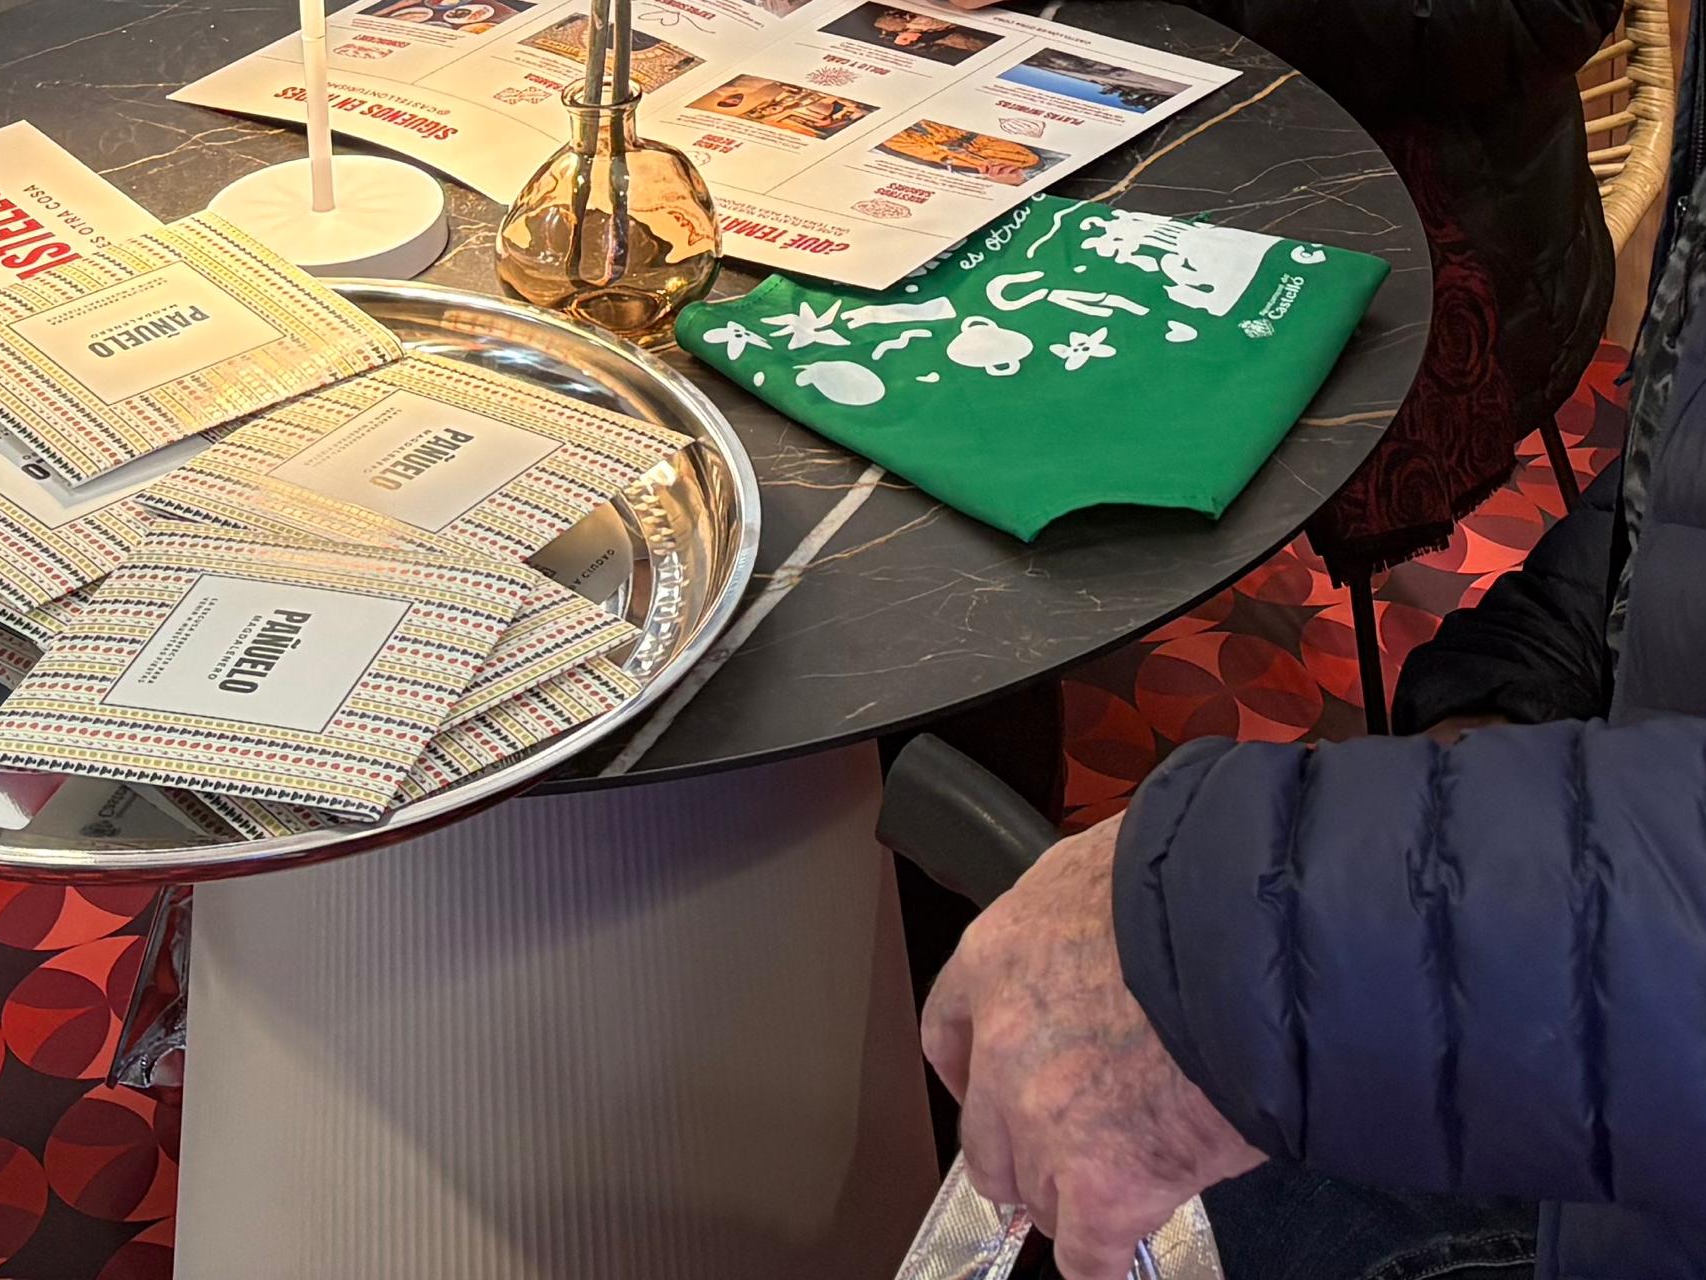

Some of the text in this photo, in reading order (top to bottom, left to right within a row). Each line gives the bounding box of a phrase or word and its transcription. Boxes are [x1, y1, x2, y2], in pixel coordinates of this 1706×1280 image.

[331, 96, 368, 112] EN
[359, 103, 459, 141] SÍGUENOS
[23, 184, 61, 210] COSA
[56, 209, 95, 236] OTRA
[779, 233, 850, 255] ¿QUÉ
[959, 251, 984, 270] es
[985, 206, 1031, 251] otra
[1267, 275, 1305, 320] Castelló
[87, 304, 211, 358] PAÑUELO
[369, 427, 475, 491] PAÑUELO
[207, 614, 263, 681] MAGDALENERO
[218, 609, 312, 694] PAÑUELO
